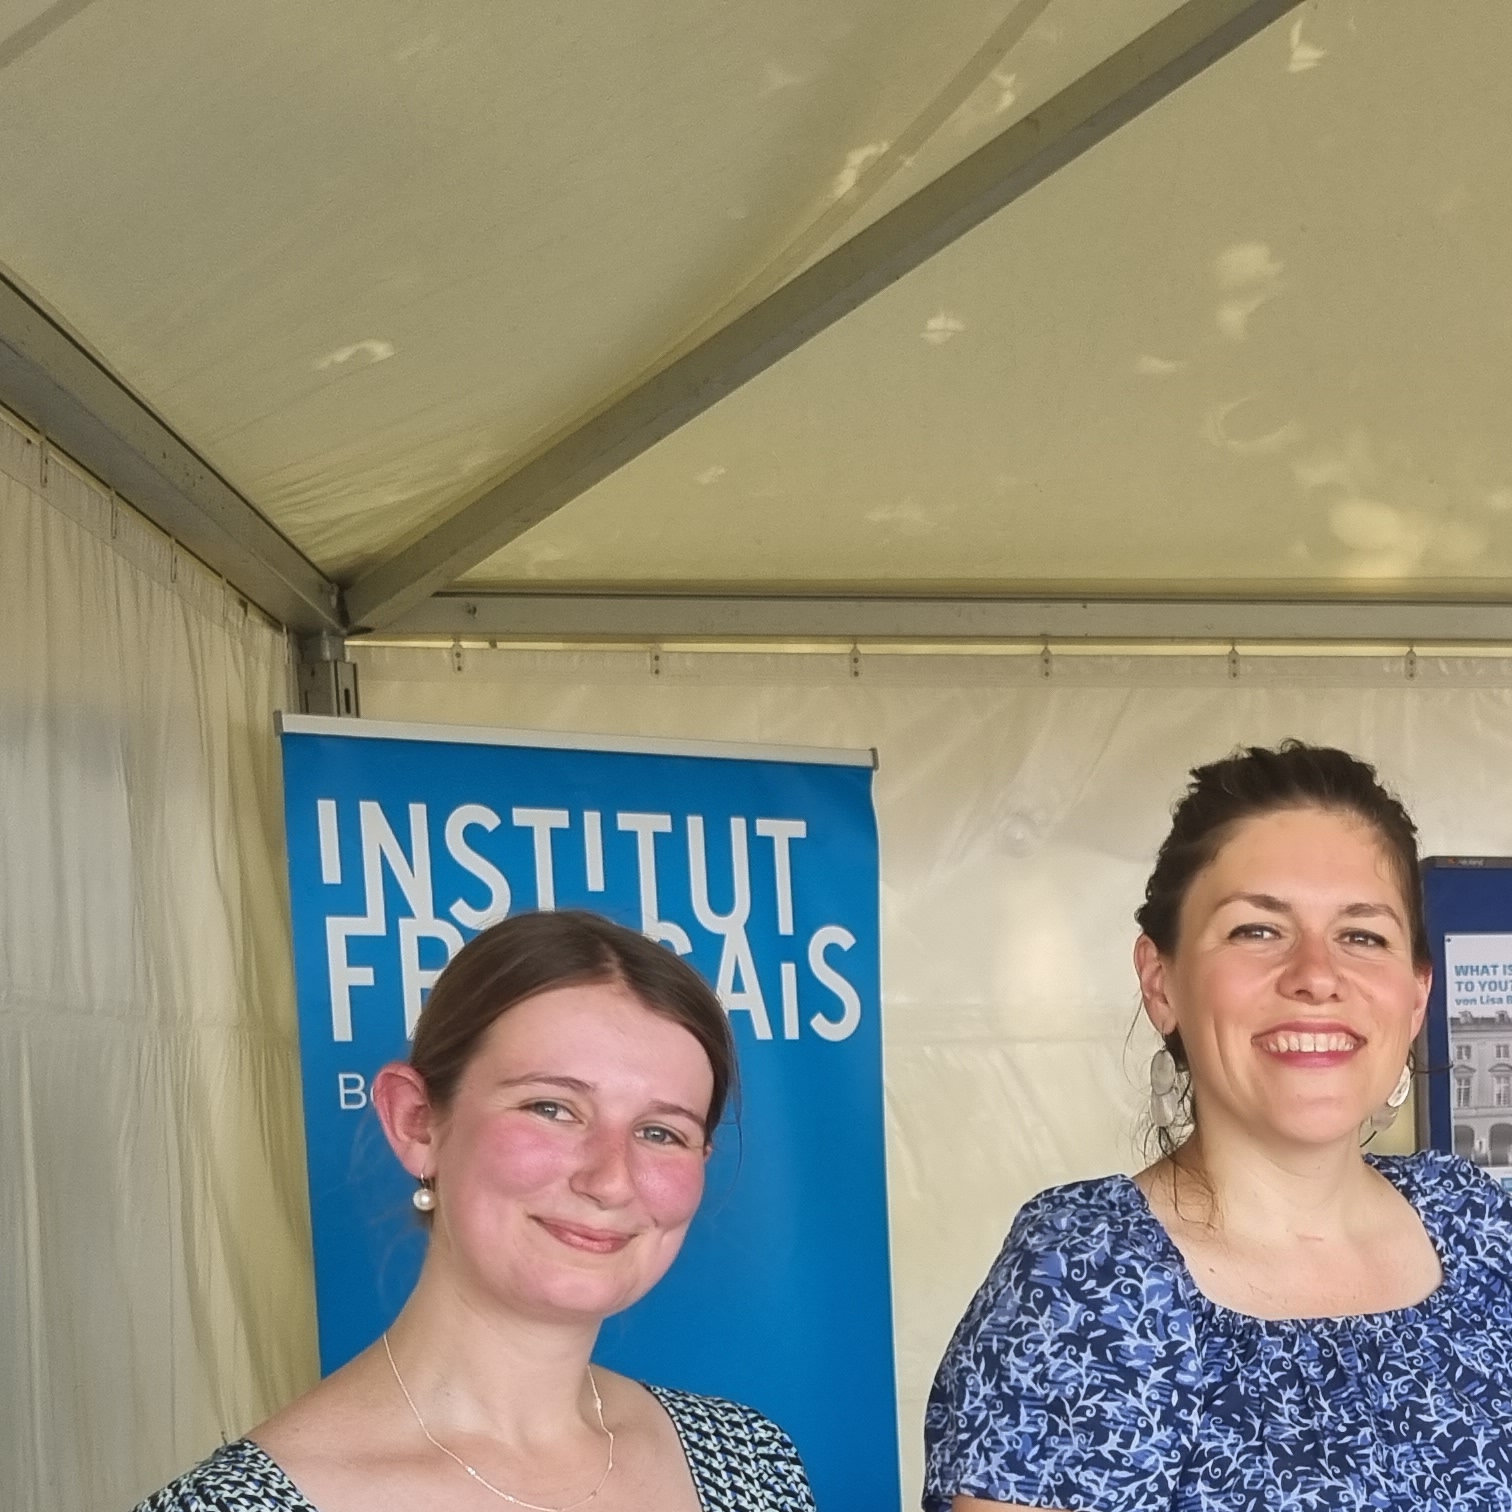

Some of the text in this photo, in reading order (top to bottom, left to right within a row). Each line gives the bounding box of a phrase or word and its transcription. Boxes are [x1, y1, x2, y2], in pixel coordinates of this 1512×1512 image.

[317, 799, 807, 936] INSTITUT
[1454, 964, 1499, 976] WHAT
[1455, 981, 1475, 992] TO
[1455, 998, 1477, 1006] von
[1480, 996, 1503, 1005] Lisa
